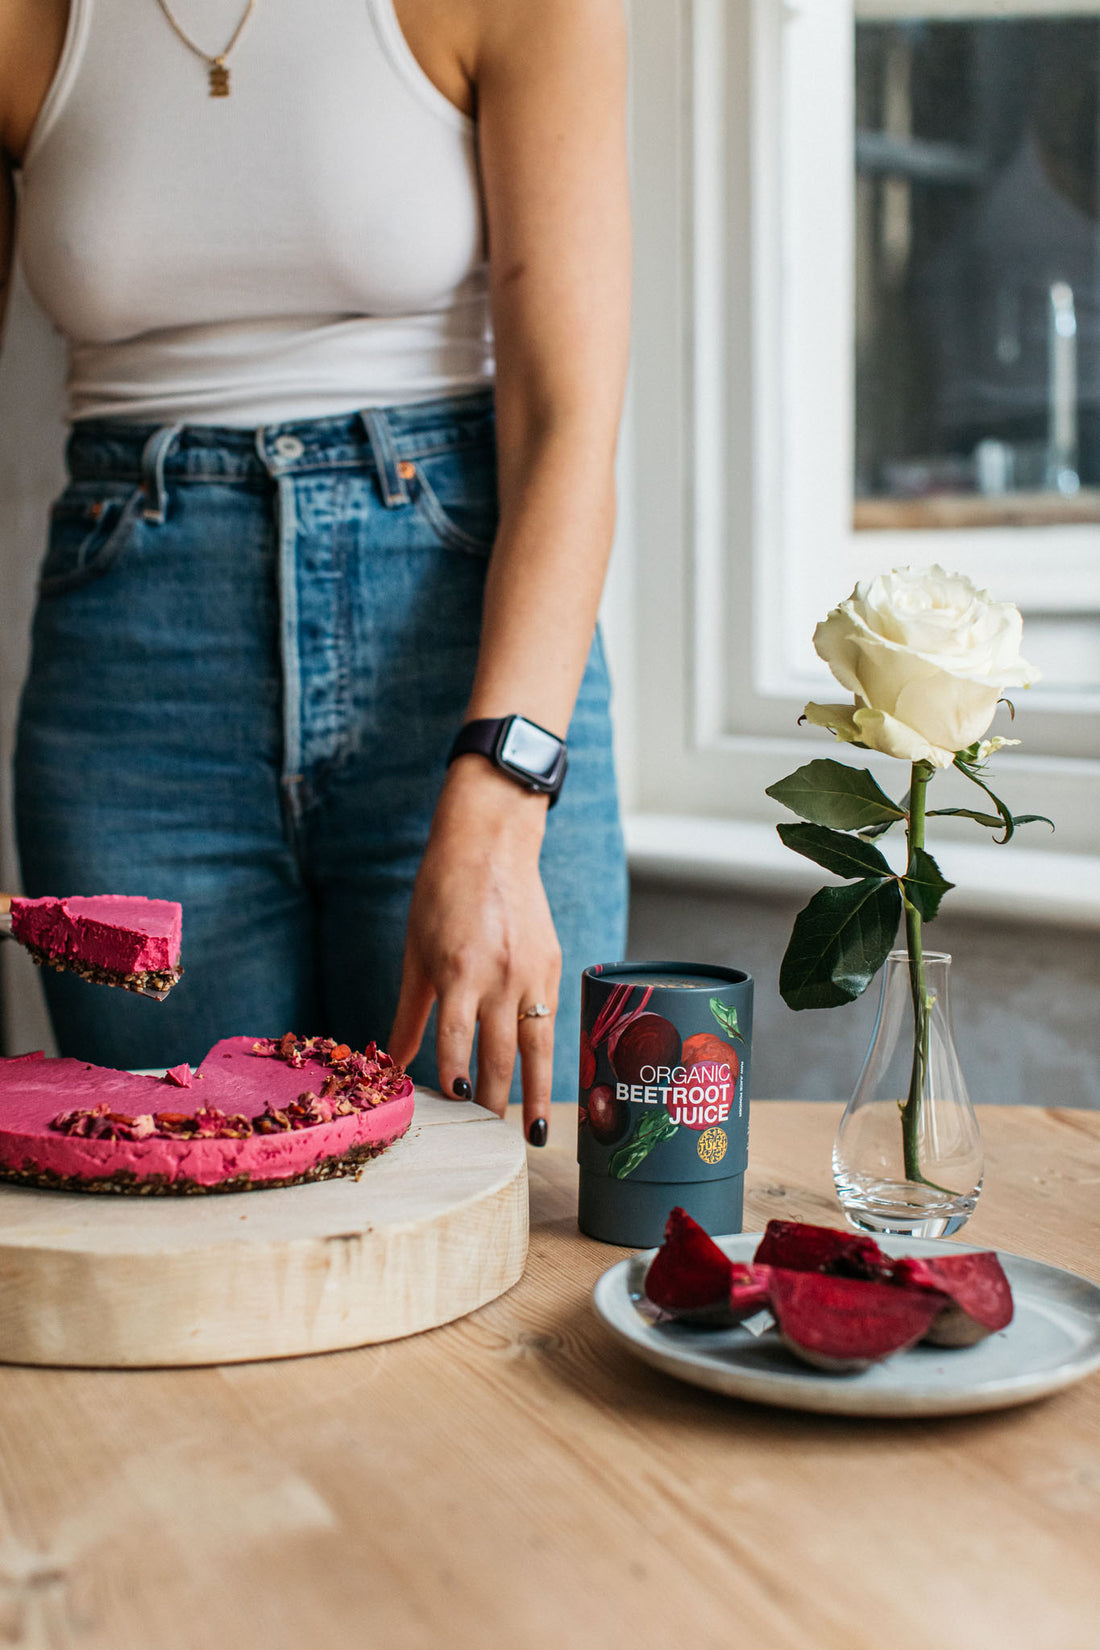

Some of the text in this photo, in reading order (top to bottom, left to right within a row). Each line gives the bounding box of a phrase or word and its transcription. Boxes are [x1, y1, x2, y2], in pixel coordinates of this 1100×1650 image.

[640, 1063, 731, 1084] ORGANIC
[616, 1082, 730, 1105] BEETROOT
[669, 1104, 729, 1125] JUICE
